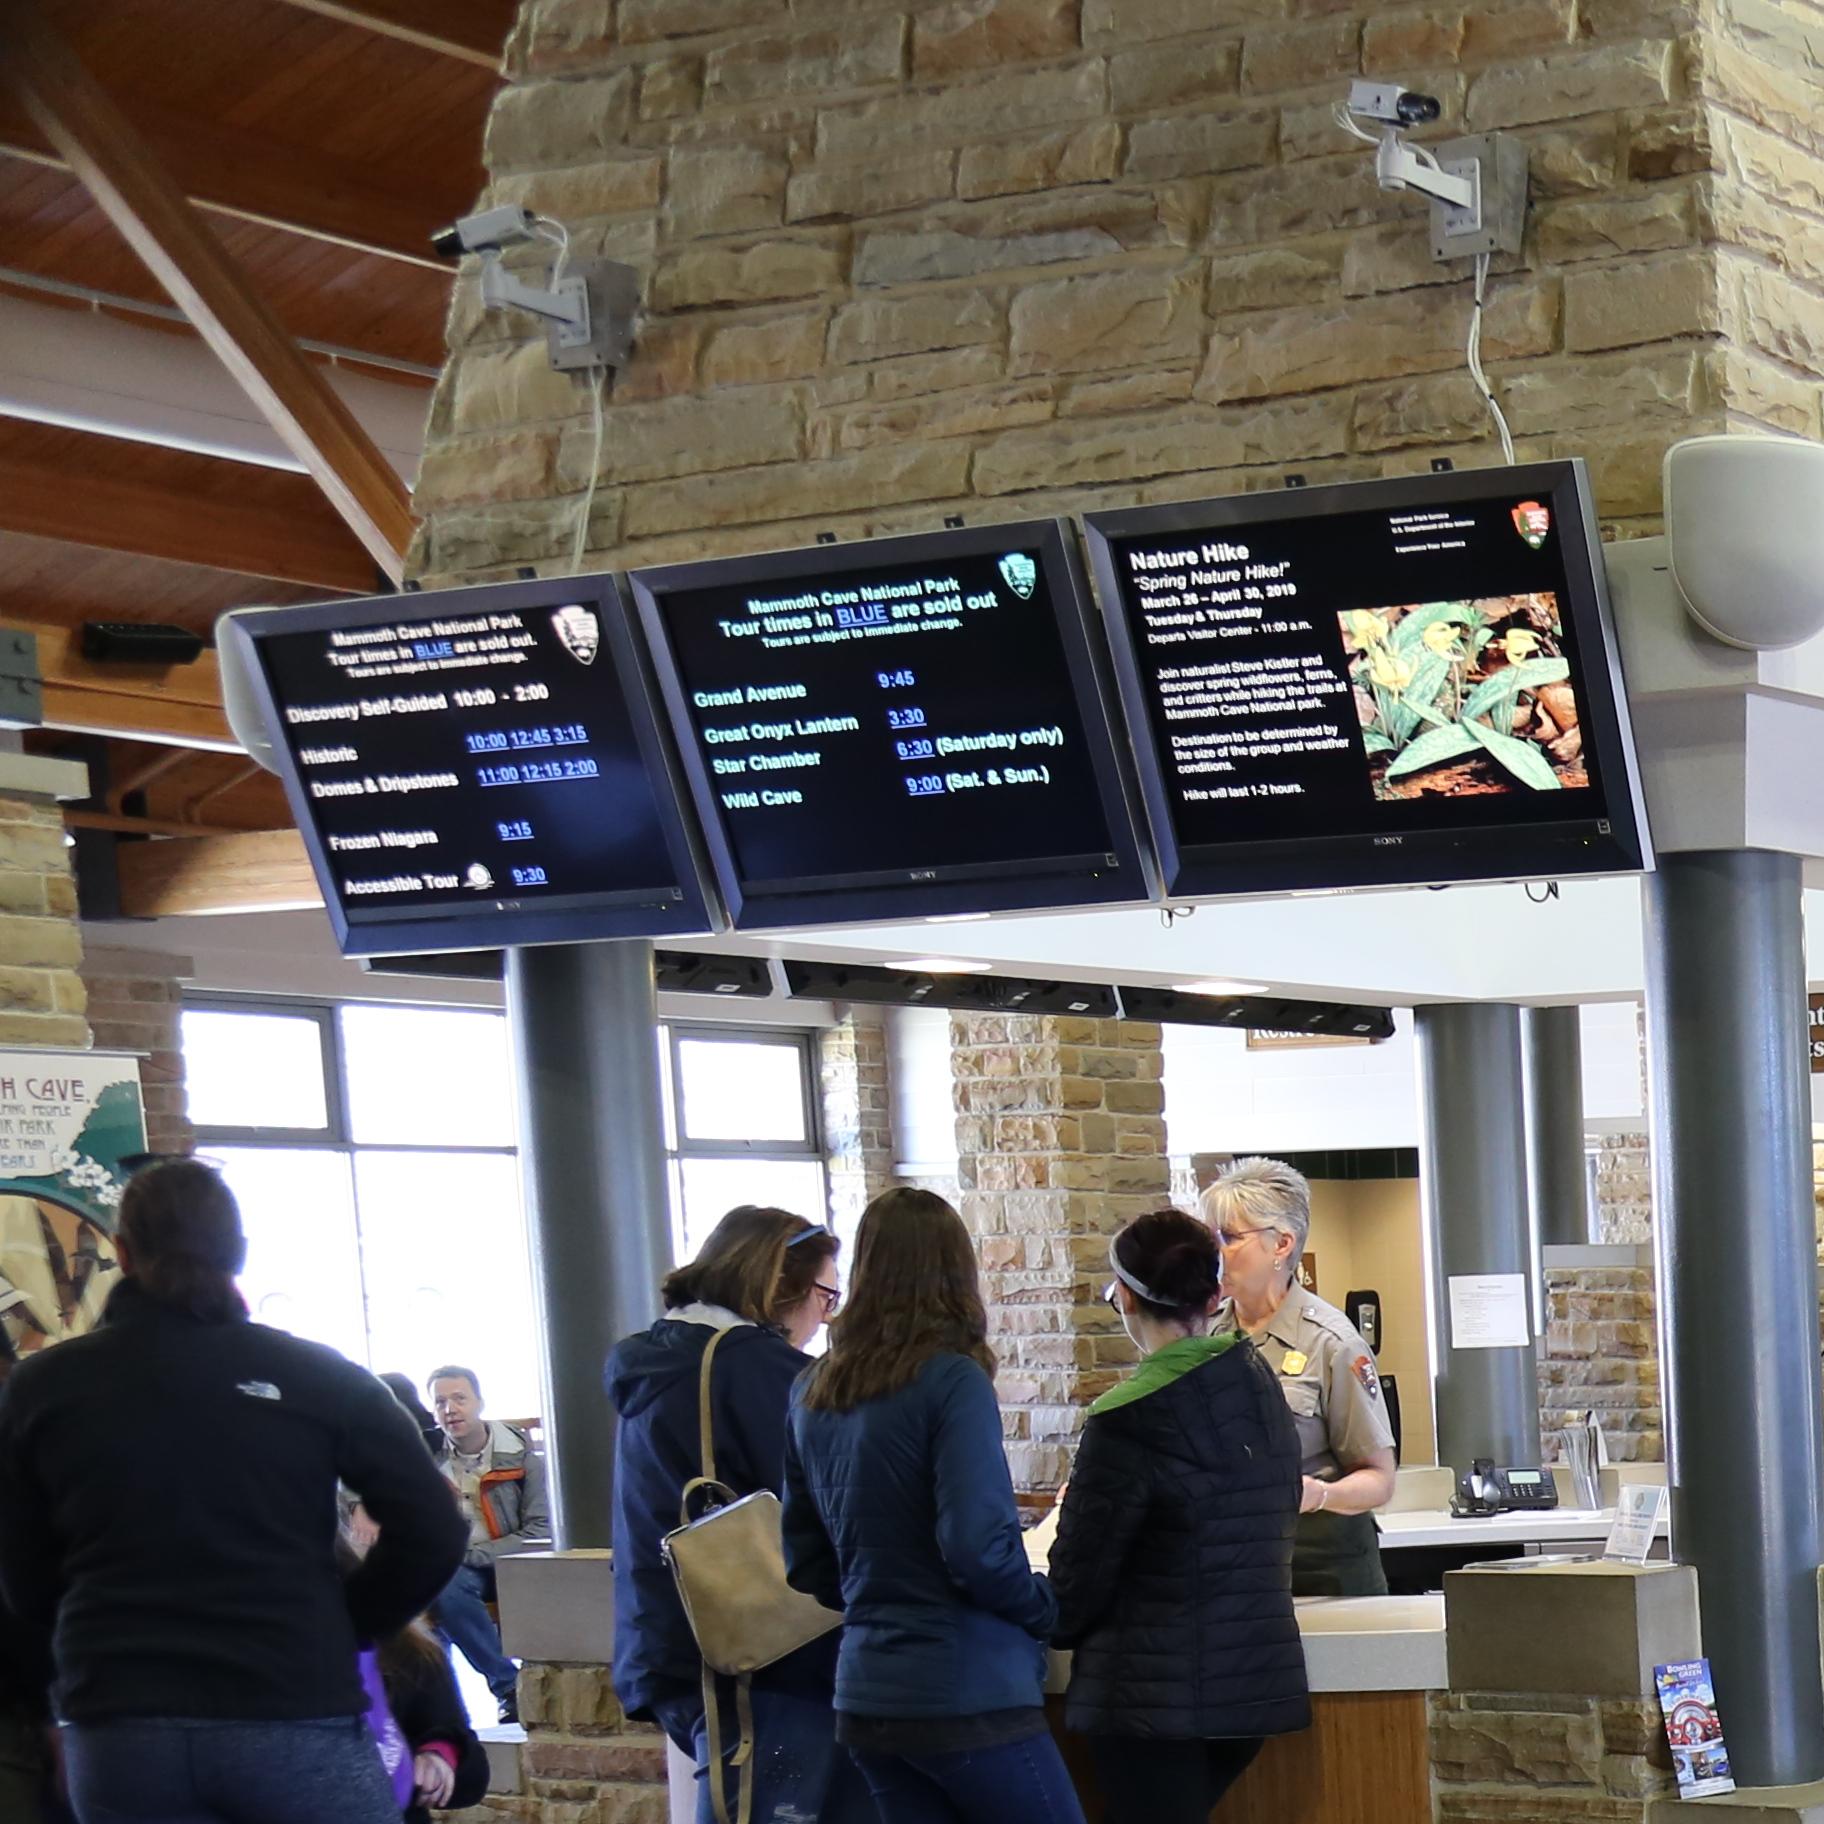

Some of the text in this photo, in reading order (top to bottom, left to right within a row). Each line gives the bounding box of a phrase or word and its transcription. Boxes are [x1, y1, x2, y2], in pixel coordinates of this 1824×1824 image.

[1129, 542, 1249, 570] Nature Hike
[1190, 569, 1241, 585] Nature
[747, 577, 960, 614] Mammoth Cave National Park
[1140, 594, 1181, 609] March
[1182, 592, 1199, 605] 26
[1211, 588, 1241, 604] April
[1265, 582, 1296, 597] 2019
[718, 591, 998, 637] Tour times in BLUE are sold out
[1144, 612, 1194, 626] Tuesday
[1205, 605, 1262, 620] Thursday
[331, 614, 523, 646] Mammoth Cave National Park
[761, 636, 793, 648] Tours
[792, 634, 810, 645] are
[811, 628, 850, 643] subject
[850, 627, 863, 638] to
[863, 621, 919, 636] immediate
[327, 633, 537, 665] Tour times in BLUE are sold out.
[1157, 654, 1323, 679] Join naturalist Steve Kistler and
[693, 670, 914, 707] Grand Avenue 9:45
[1159, 680, 1207, 693] discover
[1205, 676, 1240, 690] spring
[1163, 680, 1347, 706] and critters while hiking the trails at
[286, 704, 359, 723] Discovery
[359, 693, 448, 716] Self-Guided
[453, 688, 496, 707] 10:00
[514, 683, 549, 701] 2:00
[1165, 705, 1219, 719] Mammoth
[1219, 704, 1249, 715] Cave
[1249, 698, 1296, 713] National
[704, 707, 925, 743] Great Onyx Lantern 3:30
[1171, 724, 1338, 747] Destination to be determined by
[300, 725, 588, 764] Historic 10:00 12:45 3:15
[712, 726, 1063, 774] Star Chamber 6:30 (Saturday only)
[1173, 737, 1349, 760] the size of the group and weather
[311, 781, 365, 797] Domes
[377, 772, 459, 793] Dripstones
[477, 765, 519, 783] 11:00
[519, 761, 566, 780] 12:15
[561, 759, 599, 776] 2:00
[721, 791, 759, 809] Wild
[760, 789, 802, 805] Cave
[905, 775, 944, 793] 9:00
[945, 771, 984, 792] (Sat.
[1003, 764, 1049, 784] Sun.)
[1182, 789, 1208, 800] Hike
[1208, 787, 1227, 798] will
[1227, 786, 1249, 797] last
[1250, 784, 1268, 795] 1-2
[328, 821, 533, 850] Frozen Niagara 9:15
[1373, 836, 1402, 846] SONY
[344, 866, 546, 894] Accessible Tour 9:30
[1666, 1662, 1701, 1674] BOWLING
